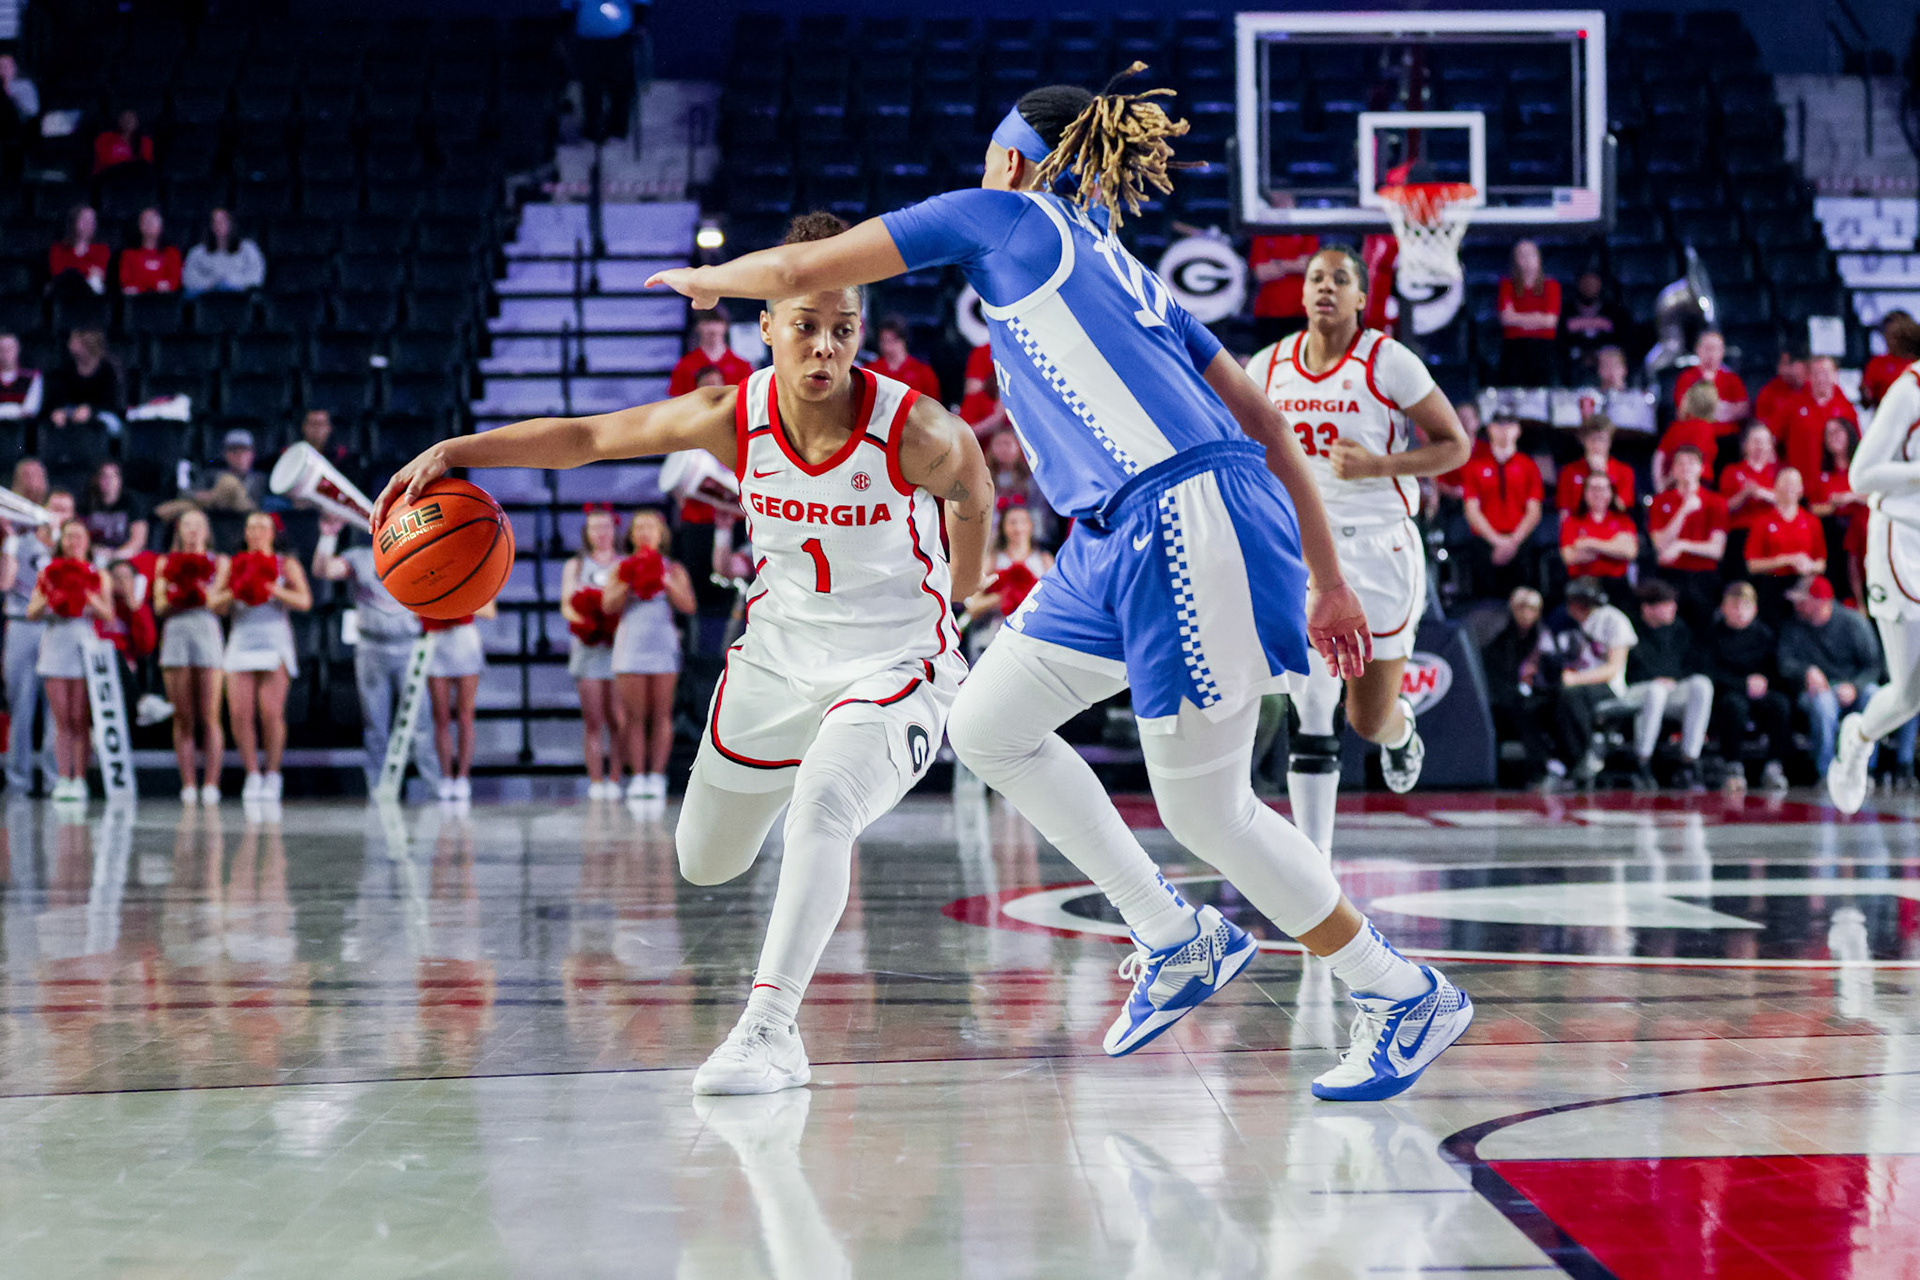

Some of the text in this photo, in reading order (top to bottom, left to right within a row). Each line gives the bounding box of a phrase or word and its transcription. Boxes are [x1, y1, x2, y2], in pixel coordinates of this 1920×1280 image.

[1171, 256, 1232, 297] G
[1274, 398, 1360, 414] GEORGIA
[1293, 421, 1339, 459] 33
[852, 473, 870, 490] SEC
[378, 502, 444, 555] ELITE
[750, 492, 892, 527] GEORGIA
[800, 537, 832, 594] 1
[95, 653, 126, 788] NOISE
